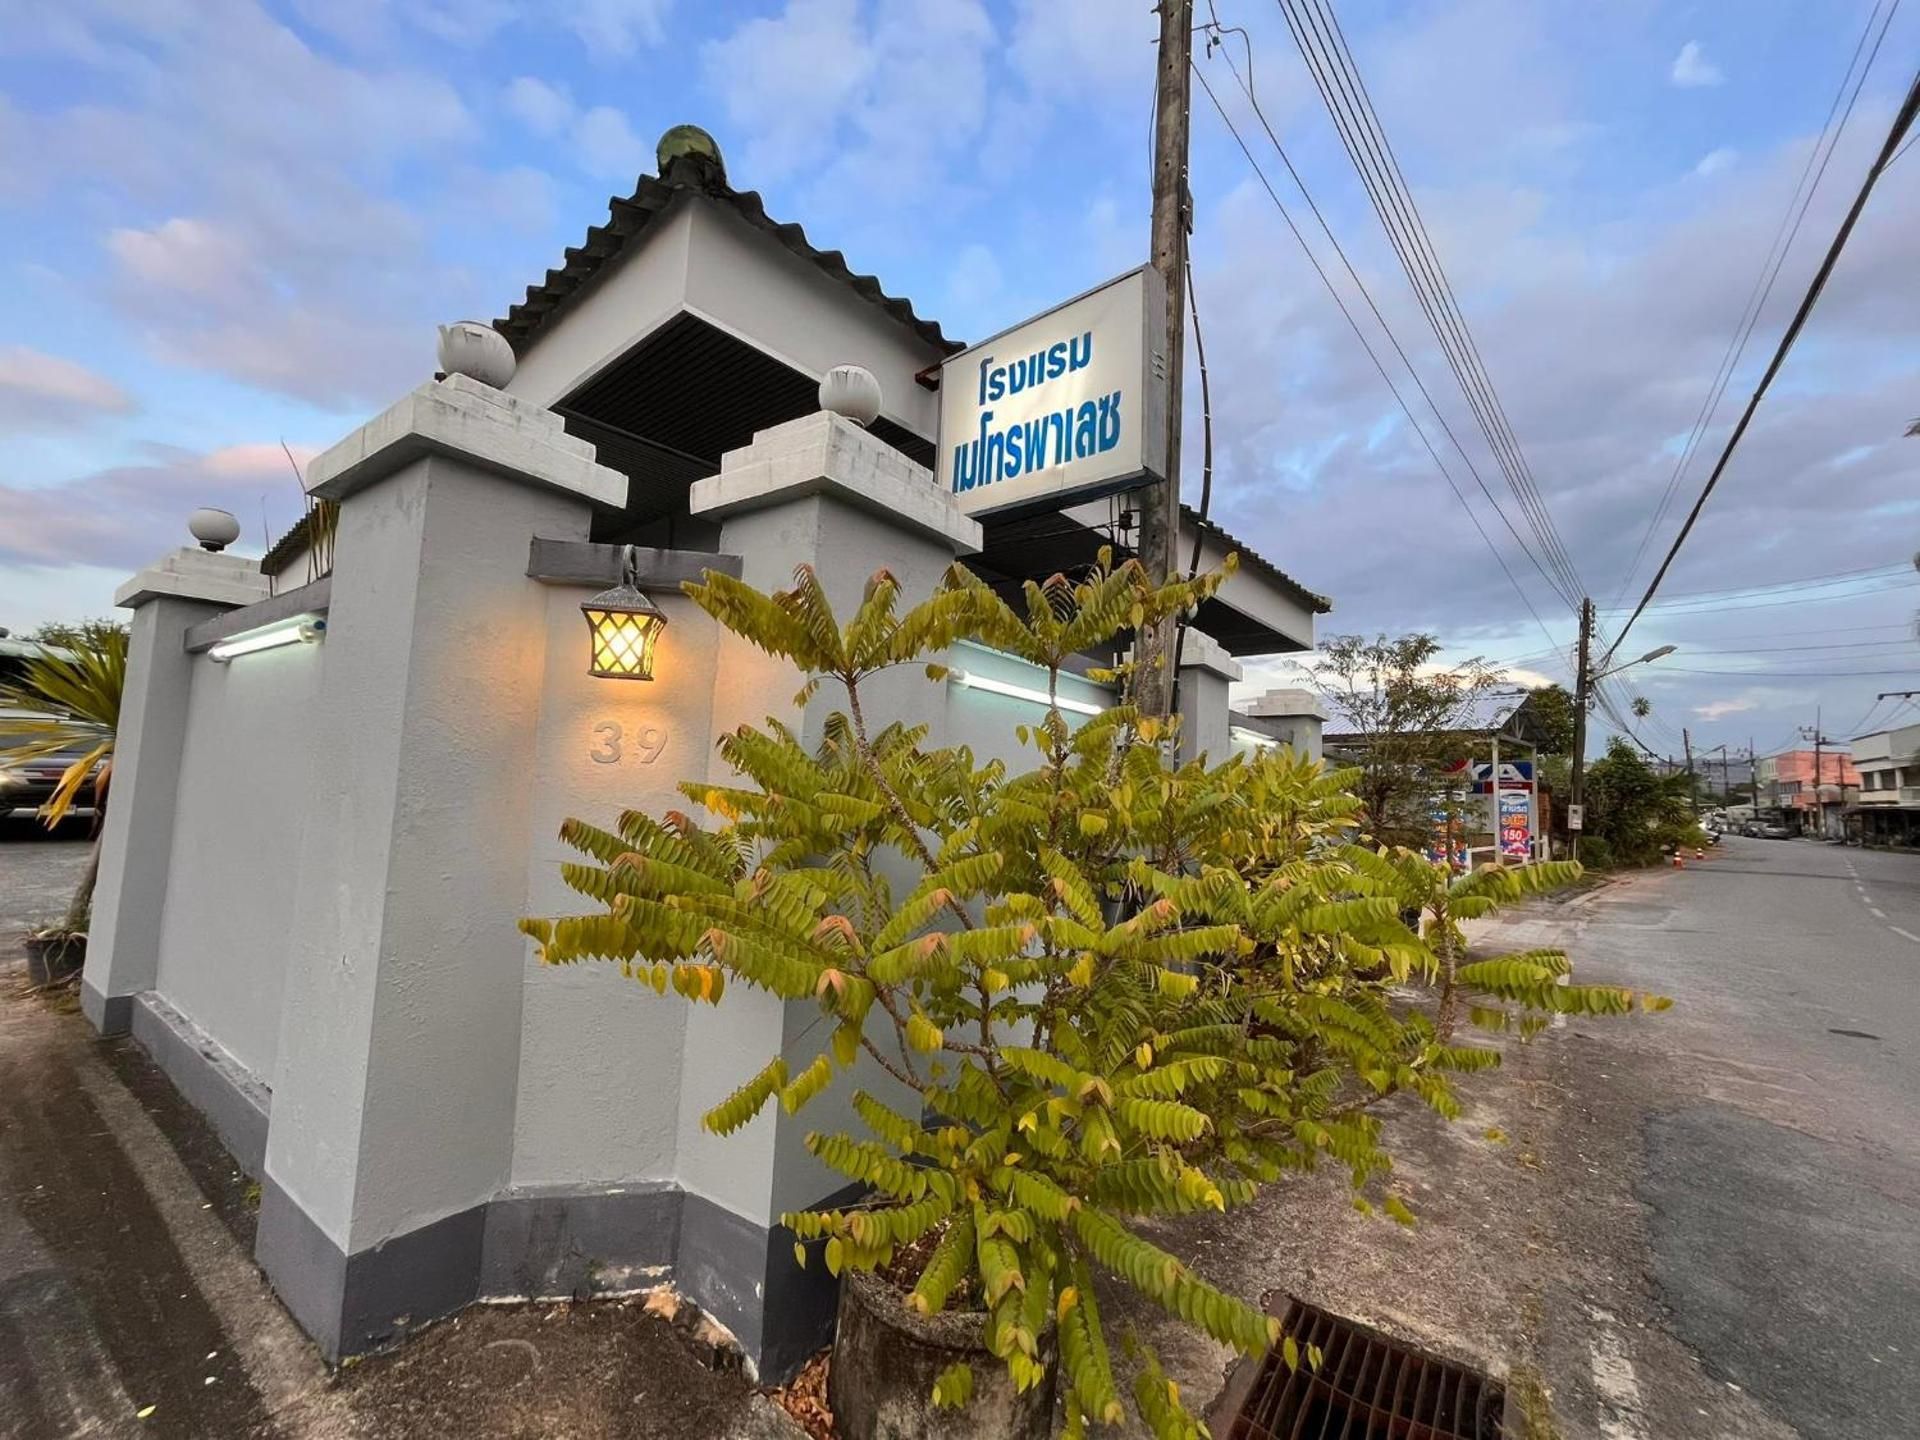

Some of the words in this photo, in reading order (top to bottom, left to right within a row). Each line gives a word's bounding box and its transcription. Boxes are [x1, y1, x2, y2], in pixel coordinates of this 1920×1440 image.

[980, 332, 1092, 406] โรงแรม
[953, 391, 1121, 493] เมโทรพาเลซ
[591, 721, 667, 763] 39
[1503, 829, 1523, 841] 150
